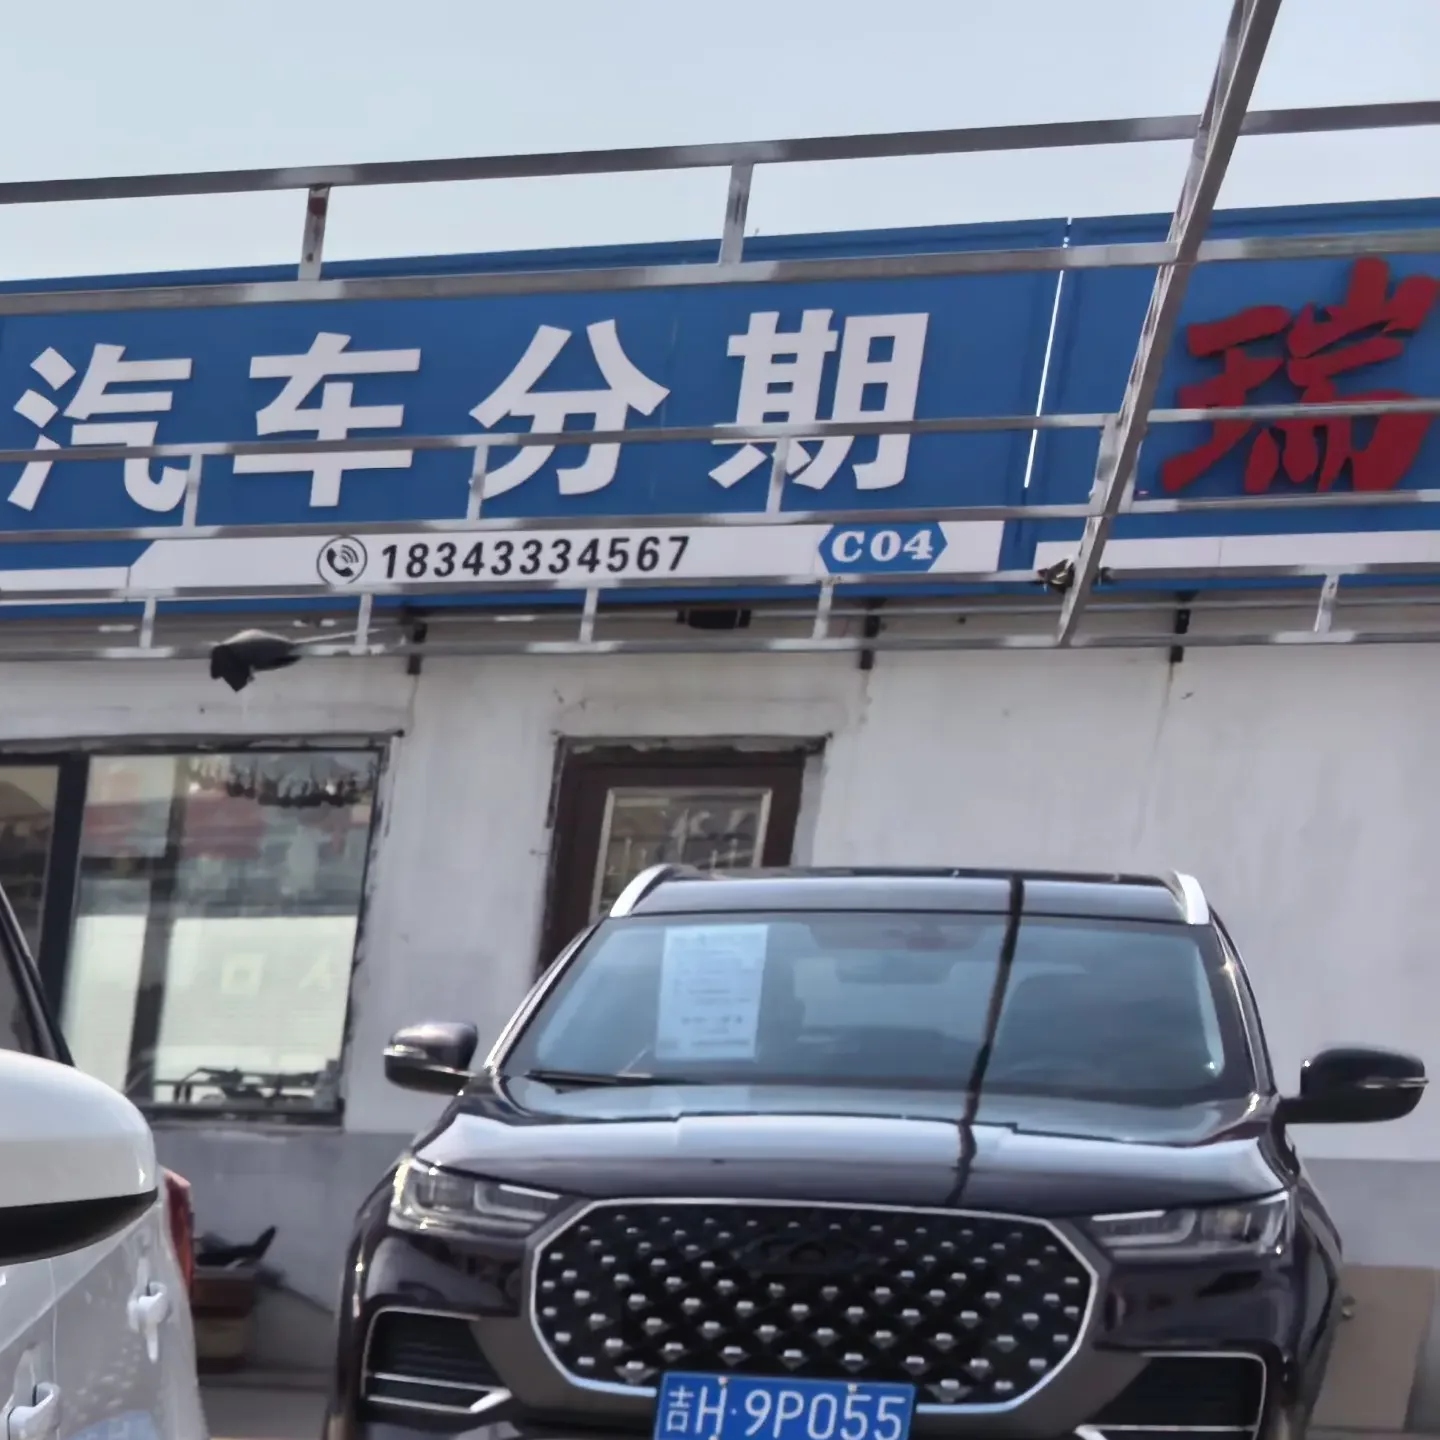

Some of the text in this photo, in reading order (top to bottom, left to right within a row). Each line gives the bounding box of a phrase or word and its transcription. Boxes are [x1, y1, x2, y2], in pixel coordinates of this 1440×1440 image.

[7, 309, 929, 511] 汽车分期
[382, 529, 933, 580] 18343334567 C04
